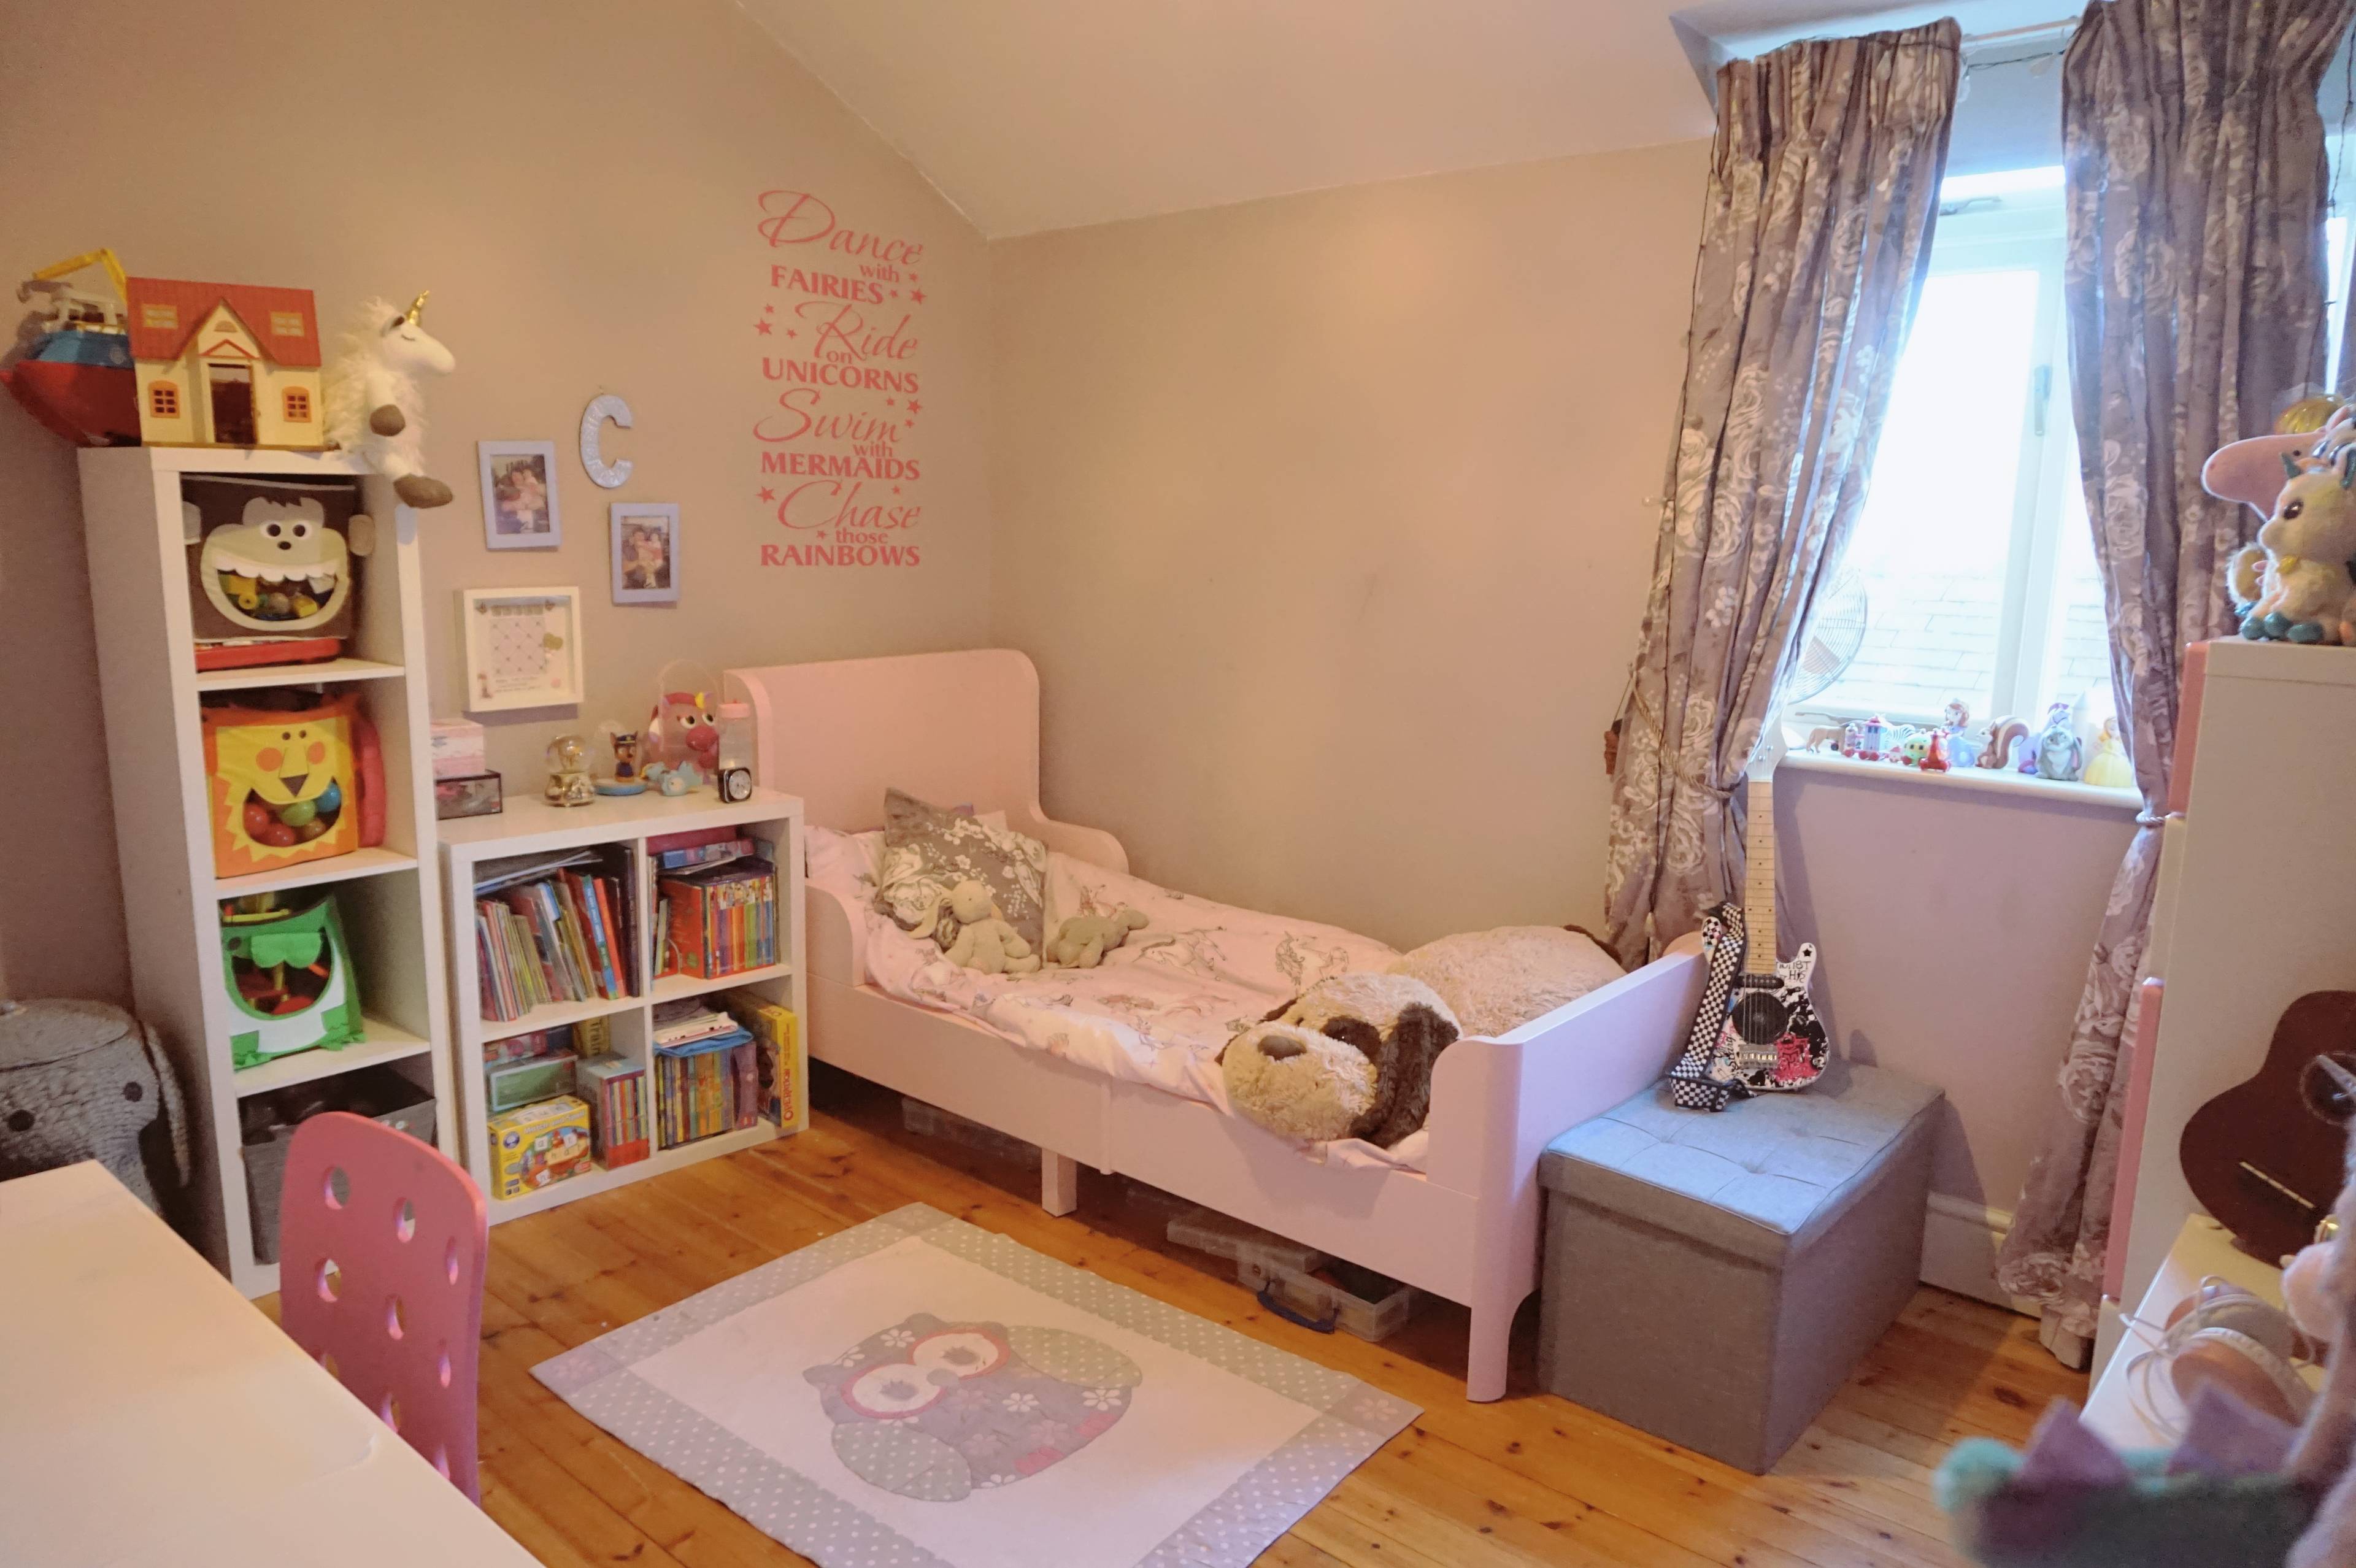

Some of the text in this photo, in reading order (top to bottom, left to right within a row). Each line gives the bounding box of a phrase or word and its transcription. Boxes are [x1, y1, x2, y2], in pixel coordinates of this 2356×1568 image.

[757, 190, 923, 266] Dance
[771, 264, 884, 305] FAIRIES
[860, 263, 900, 283] with
[795, 301, 918, 361] Ride
[826, 350, 853, 364] on
[762, 356, 919, 394] UNICORNS
[753, 387, 903, 443] Swim
[761, 451, 921, 481] MERMAIDS
[853, 440, 893, 458] with
[777, 479, 922, 529] Chase
[836, 527, 889, 544] those
[760, 544, 921, 567] RAINBOWS
